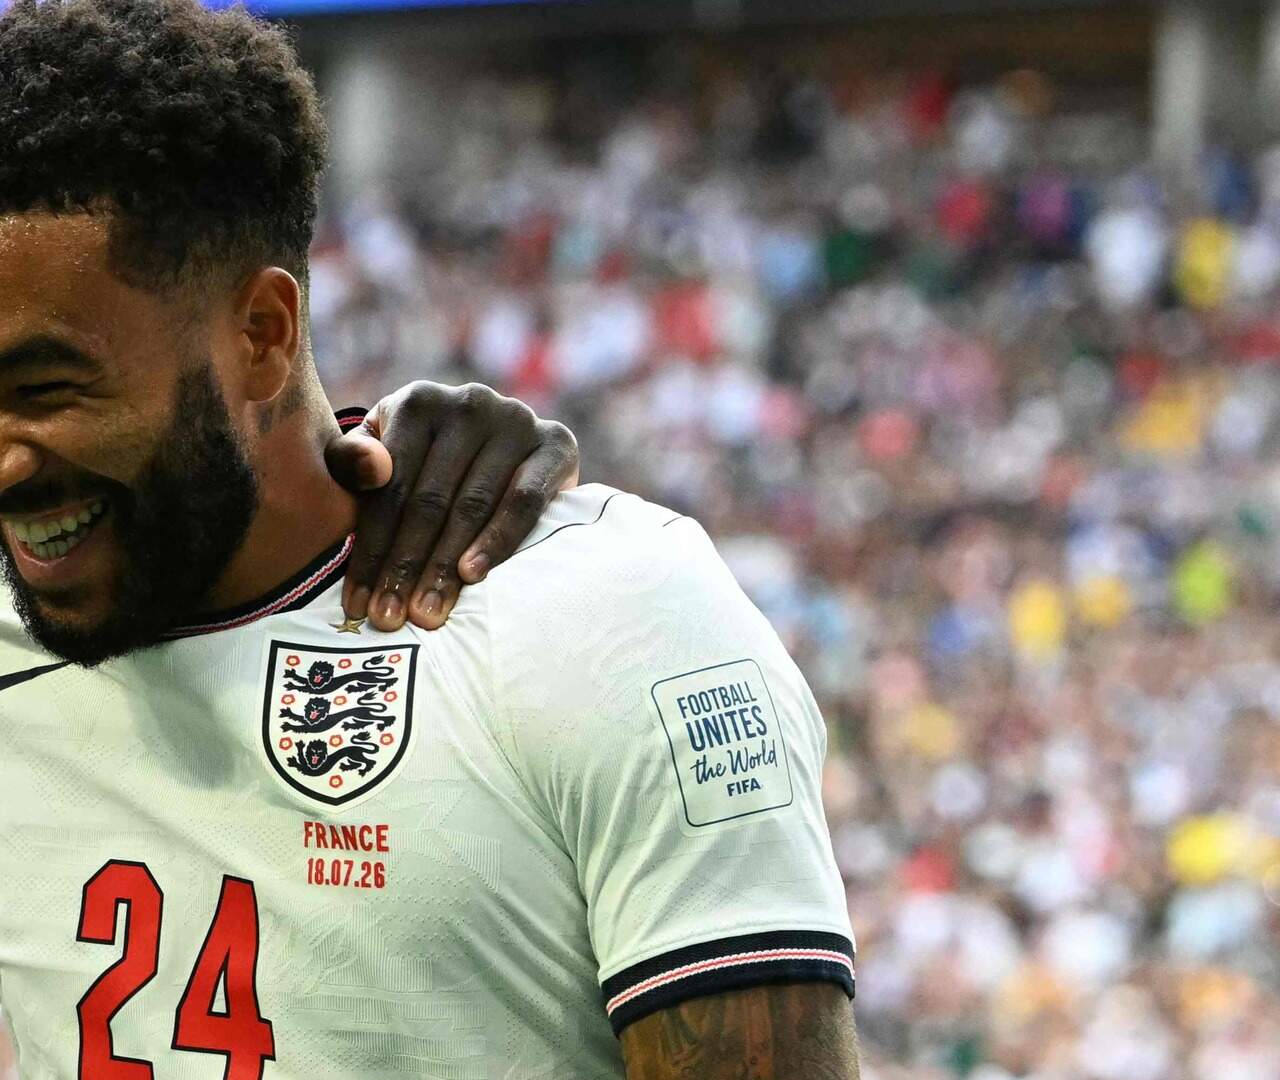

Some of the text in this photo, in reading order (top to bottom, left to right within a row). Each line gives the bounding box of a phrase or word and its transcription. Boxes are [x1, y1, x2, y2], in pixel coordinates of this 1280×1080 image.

[676, 680, 758, 719] FOOTBALL
[685, 704, 768, 752] UNITES
[690, 738, 778, 785] the World
[726, 777, 761, 797] FIFA
[304, 821, 389, 852] FRANCE
[307, 858, 385, 889] 18.07.26
